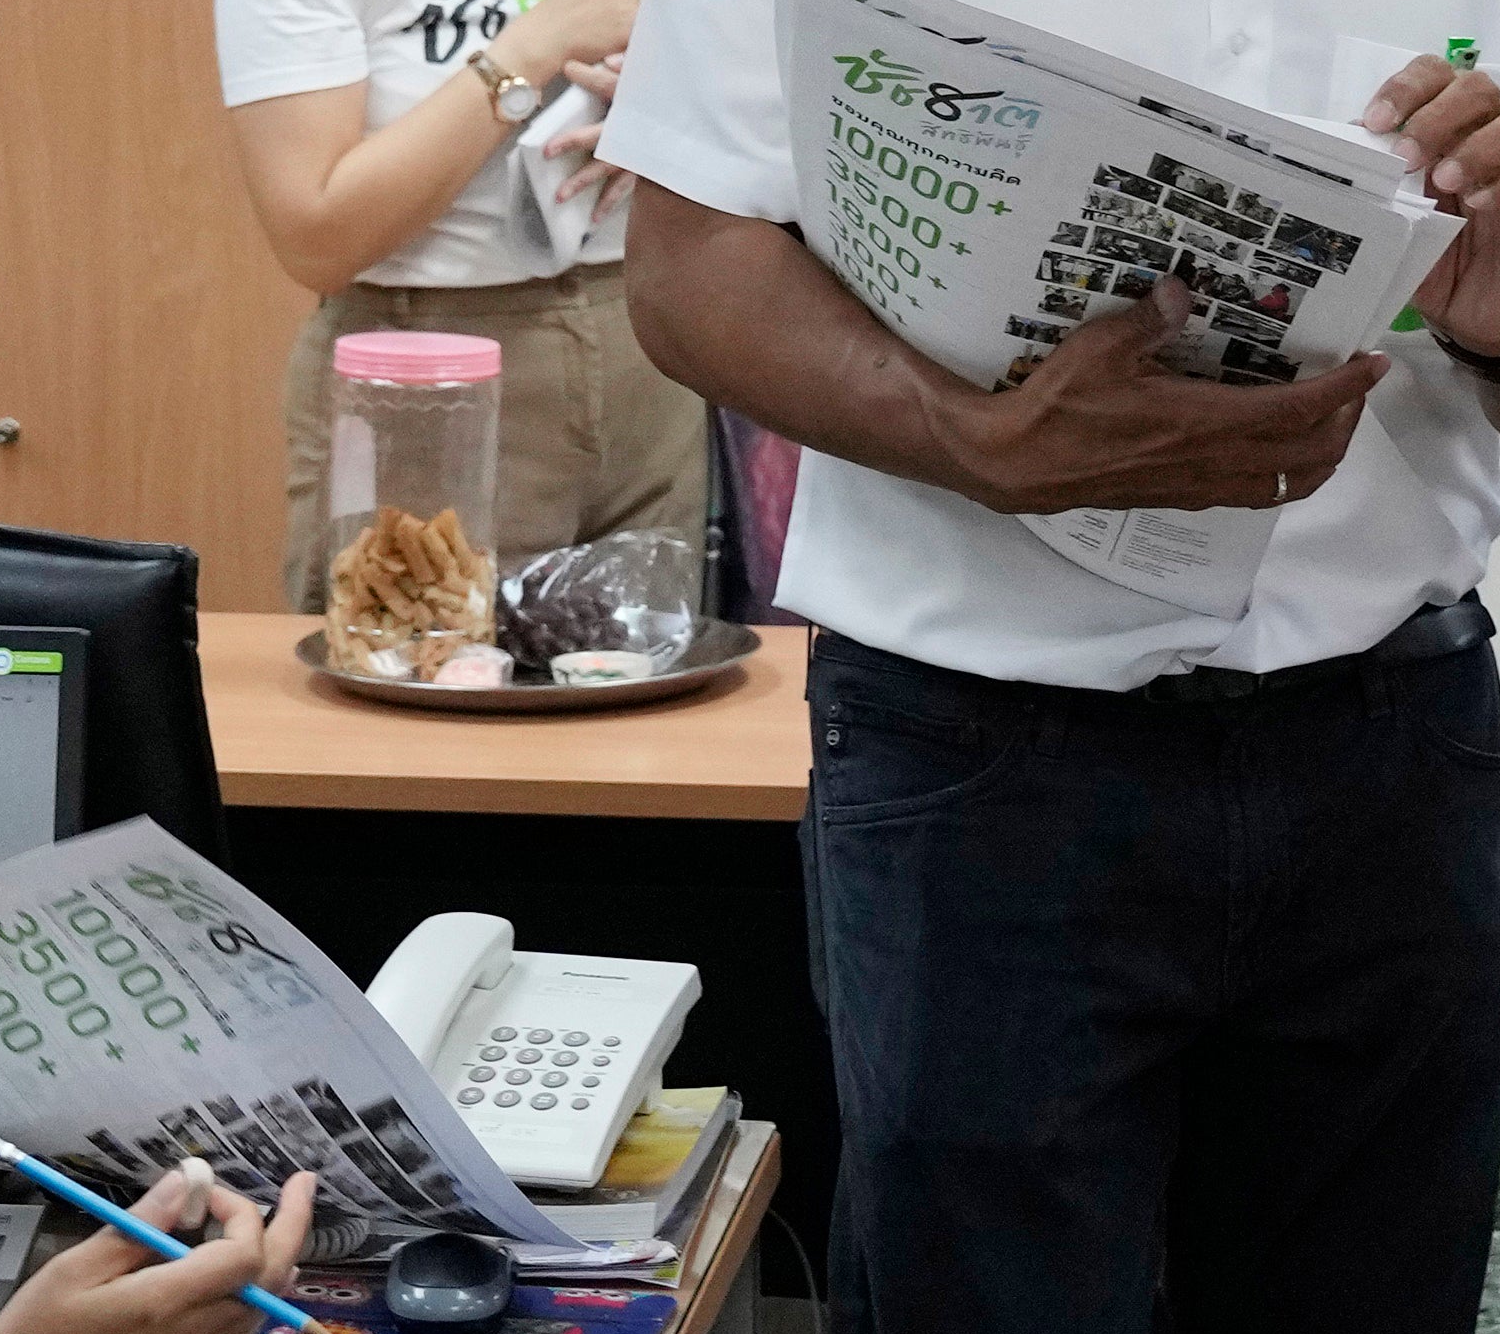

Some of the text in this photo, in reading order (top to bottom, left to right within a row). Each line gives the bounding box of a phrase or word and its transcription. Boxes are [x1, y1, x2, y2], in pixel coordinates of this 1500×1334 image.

[831, 94, 1022, 187] ขอบคุณทุกความคิด
